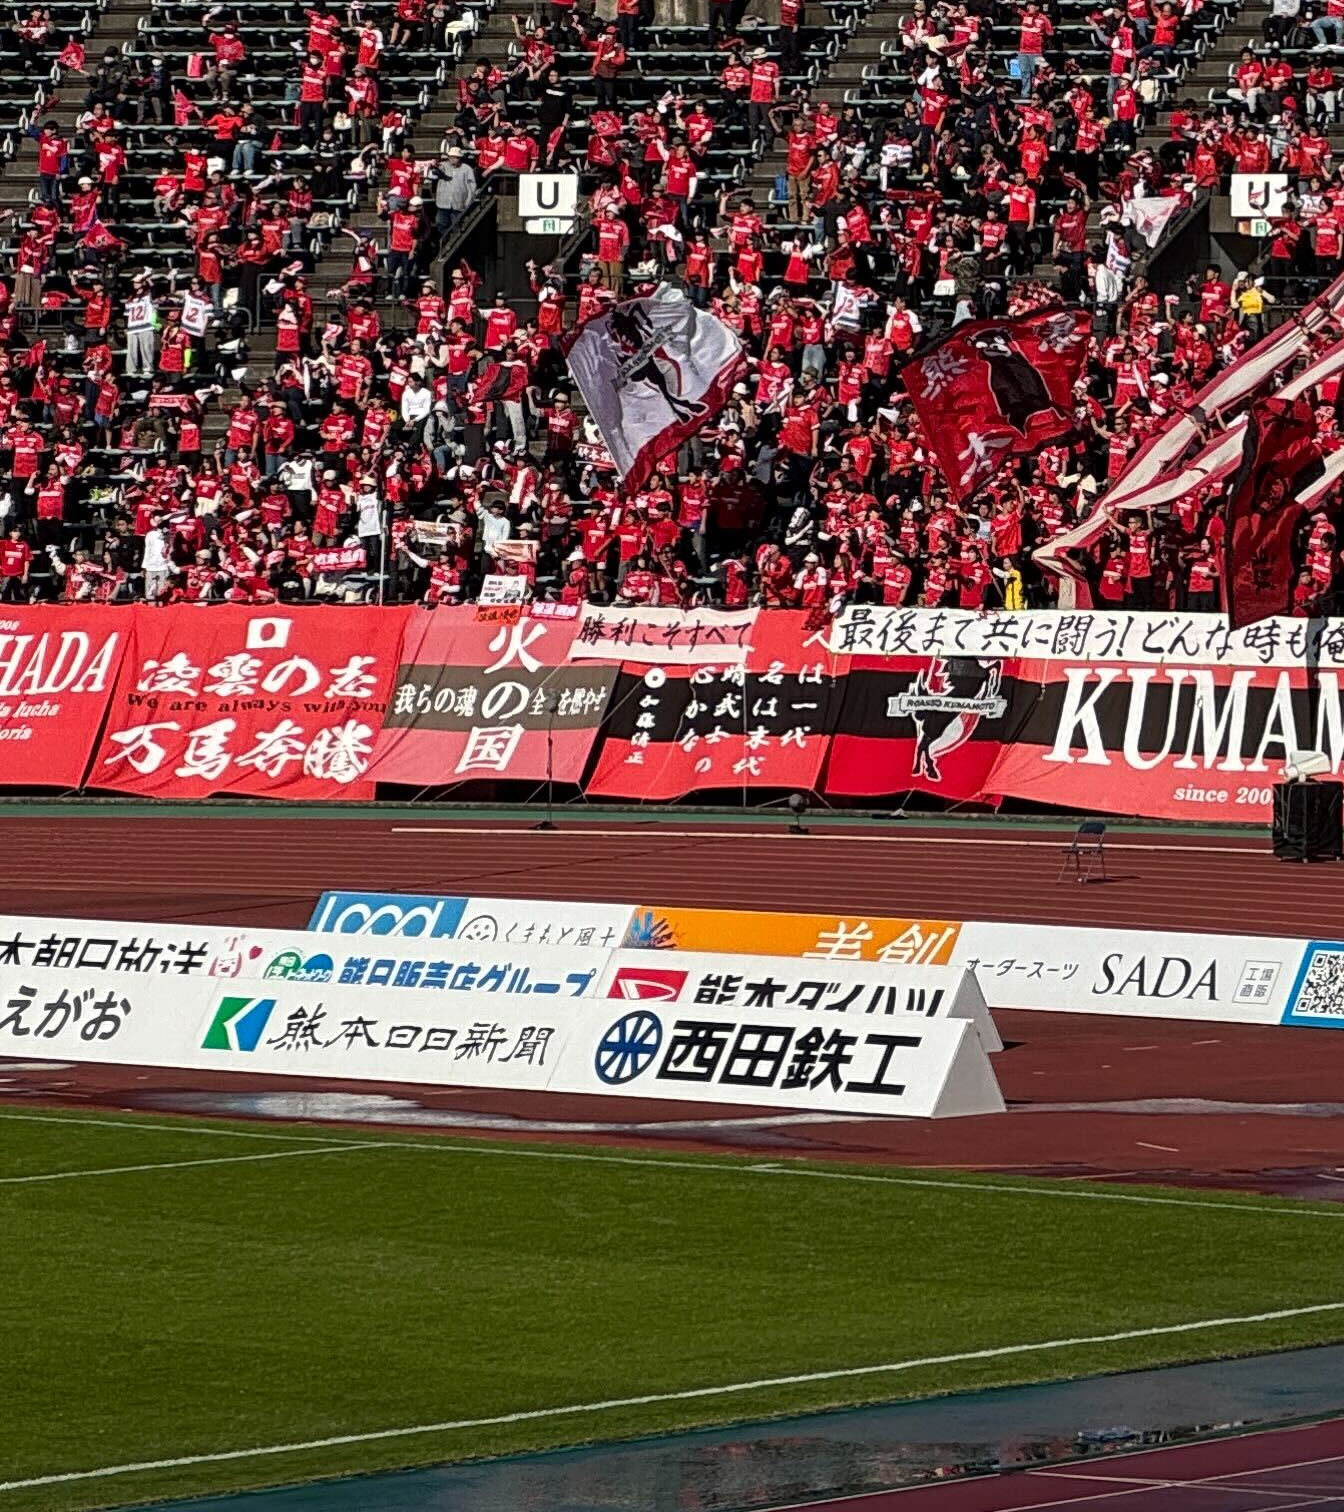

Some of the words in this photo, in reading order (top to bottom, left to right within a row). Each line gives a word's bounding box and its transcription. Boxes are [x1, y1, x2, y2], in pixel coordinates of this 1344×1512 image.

[537, 180, 559, 209] U
[1249, 180, 1270, 210] U
[129, 305, 145, 323] 12
[577, 615, 753, 653] 勝利こそすべて
[138, 652, 378, 698] 凌雲の志
[127, 692, 158, 710] We
[168, 698, 208, 712] are
[217, 697, 292, 714] always
[394, 683, 478, 718] 我らの魂
[1172, 784, 1228, 804] since
[1235, 786, 1272, 805] 200
[1091, 952, 1221, 1002] SADA
[0, 984, 132, 1041] えがお
[266, 1002, 556, 1066] 熊本日日新聞
[655, 1018, 923, 1096] 西田鉄工
